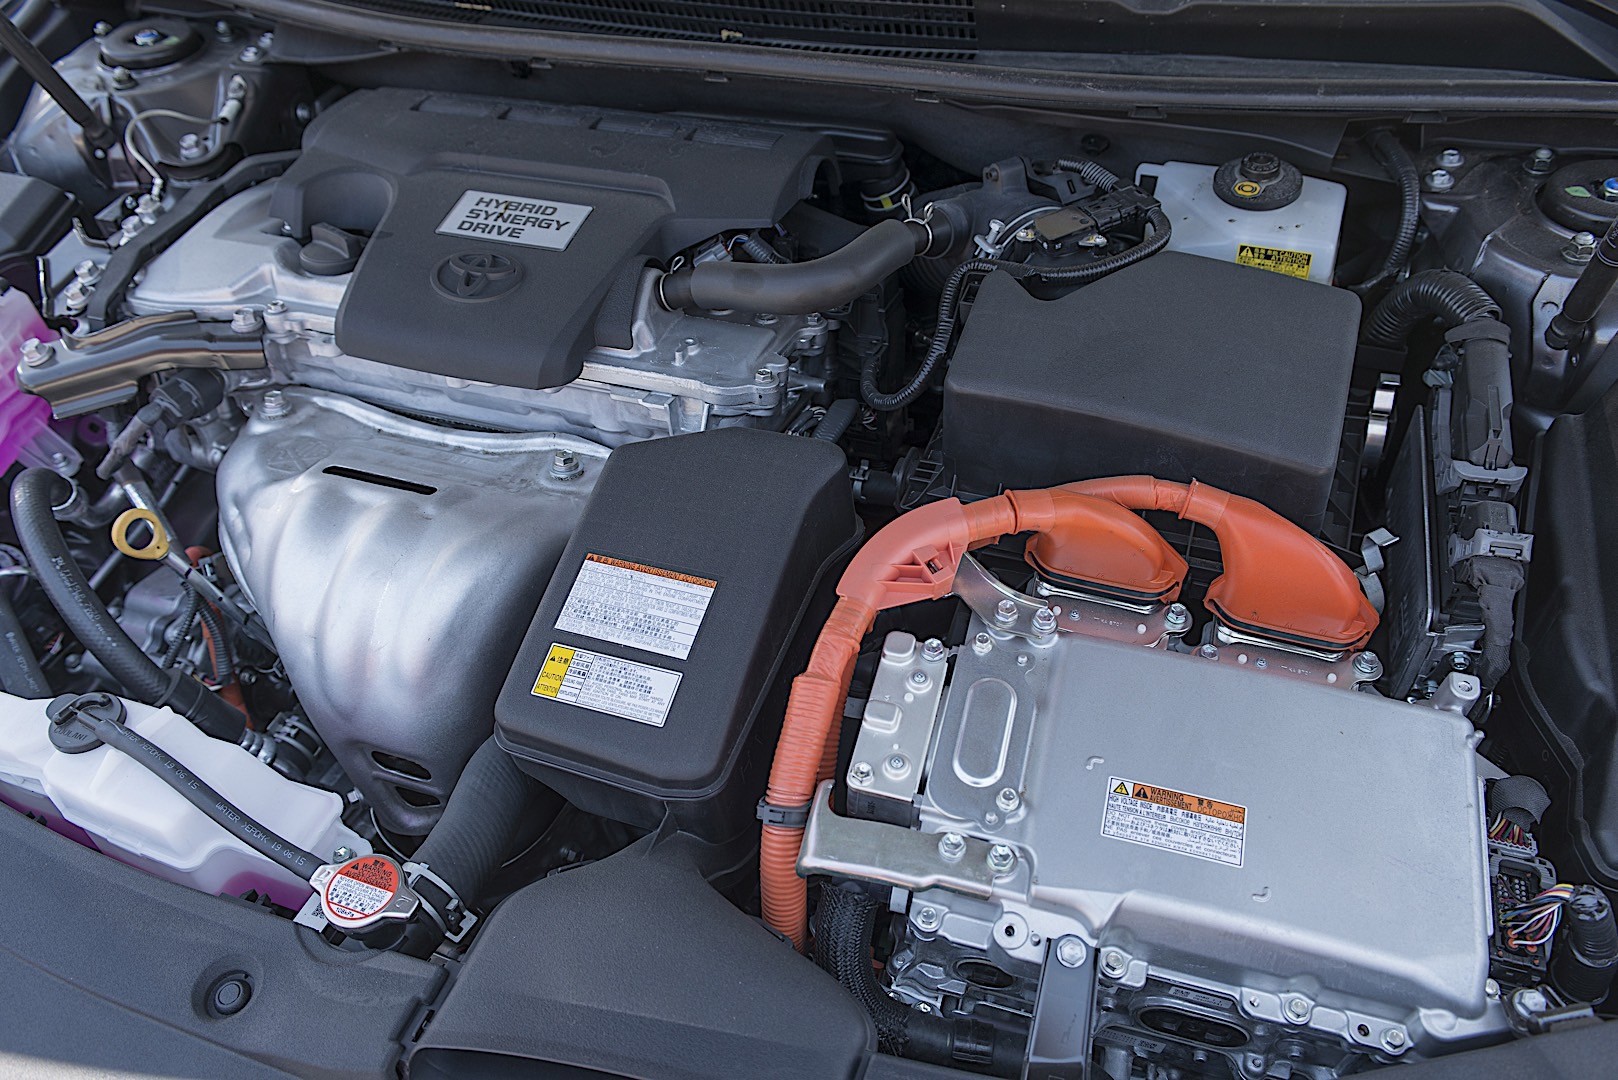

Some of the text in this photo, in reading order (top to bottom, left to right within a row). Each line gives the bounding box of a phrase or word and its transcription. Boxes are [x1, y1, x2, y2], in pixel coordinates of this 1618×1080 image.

[475, 197, 558, 216] HYBRID
[465, 208, 570, 231] SYNERGY
[457, 220, 525, 239] DRIVE
[541, 671, 563, 682] CAUTION
[536, 682, 558, 693] ATTENTION
[53, 727, 88, 741] COOLANT
[164, 760, 175, 769] 19
[176, 769, 187, 779] 06
[188, 780, 200, 790] 15
[1109, 794, 1152, 810] HIGH VOLTAGE INSIDE
[1149, 794, 1191, 810] AVERTISSEMENT
[1150, 787, 1183, 802] WARNING
[1108, 802, 1121, 810] HAUTE
[1121, 805, 1138, 814] TENSION
[1197, 804, 1243, 822] ОСТОРОЖНО
[1132, 816, 1151, 824] remove
[216, 802, 241, 824] WATER
[272, 842, 282, 851] 19
[284, 849, 294, 859] 06
[295, 856, 307, 866] 15
[1130, 830, 1149, 838] enlever
[1164, 838, 1192, 849] couvercles
[362, 862, 392, 877] WARNING
[345, 870, 392, 890] AVERTISSEMENT
